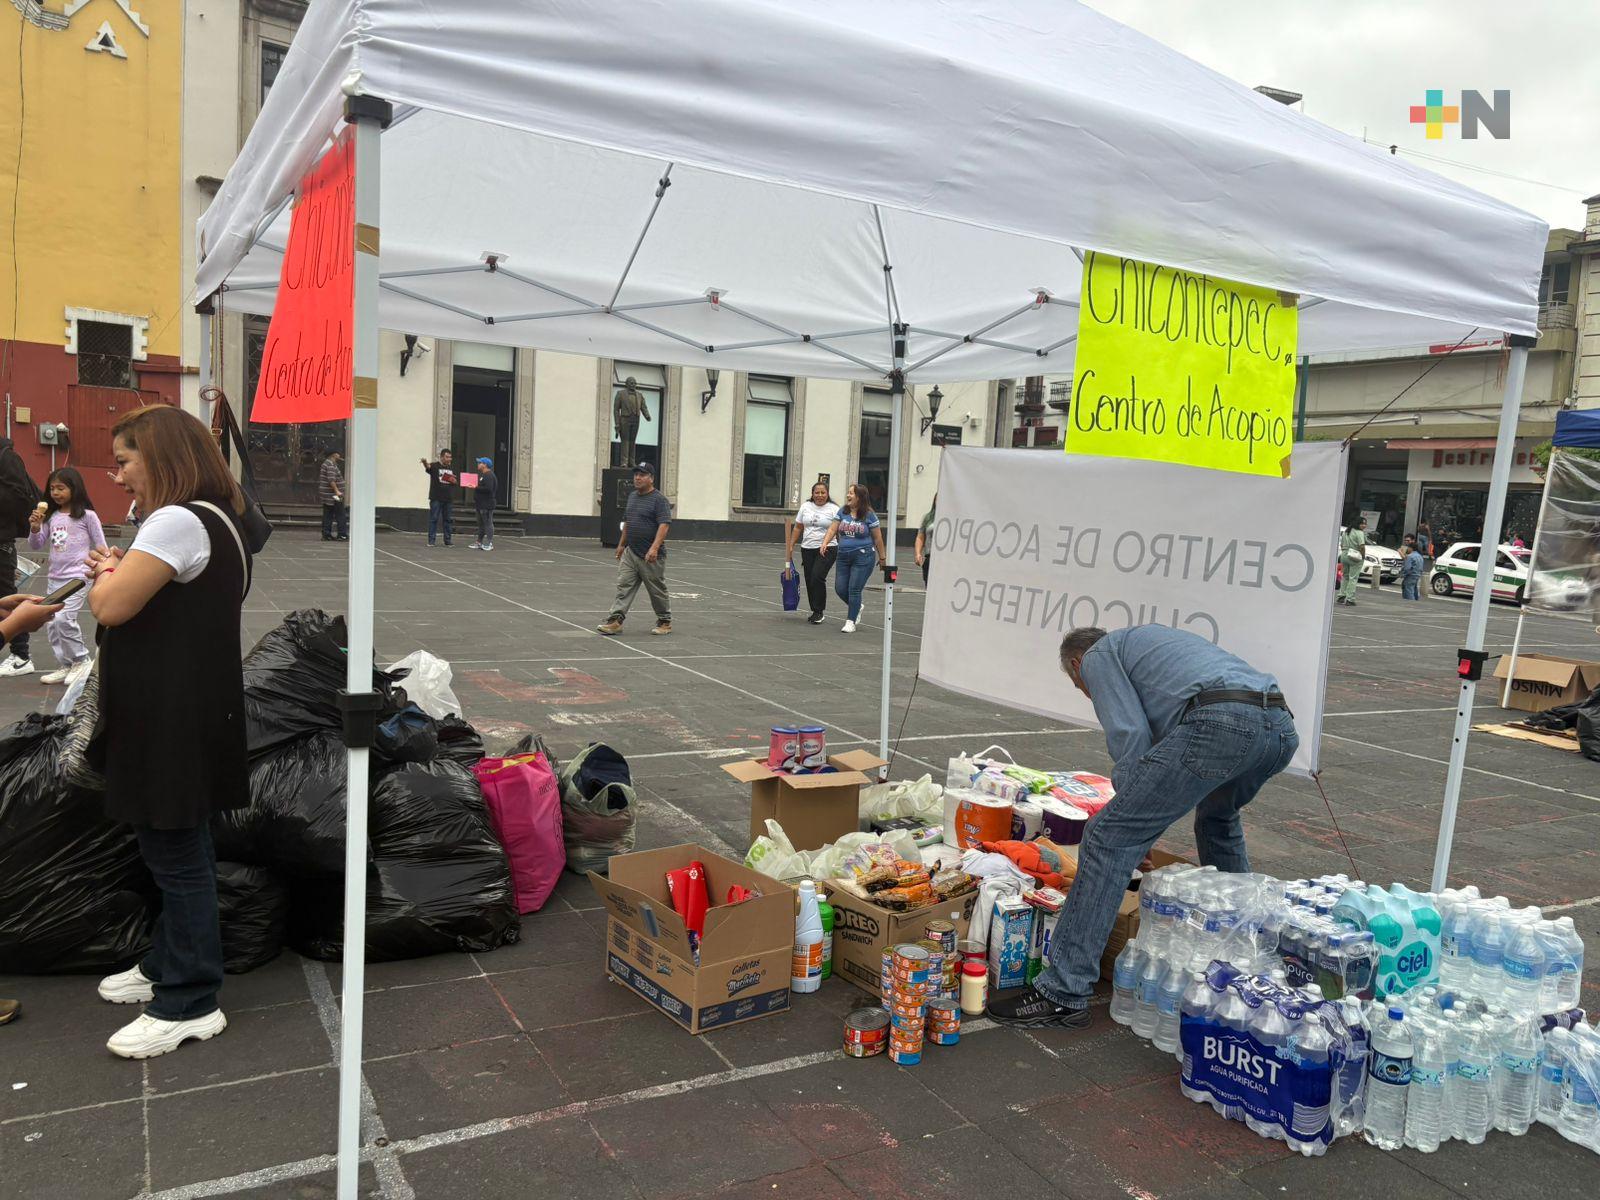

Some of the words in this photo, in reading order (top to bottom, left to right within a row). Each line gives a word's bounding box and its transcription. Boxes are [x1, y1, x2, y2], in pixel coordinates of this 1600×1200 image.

[264, 331, 314, 399] Centro
[316, 320, 332, 397] de
[332, 320, 353, 396] Aco
[1075, 370, 1166, 435] Centro
[1176, 375, 1203, 438] de
[1207, 384, 1287, 464] Acopio
[1511, 680, 1563, 698] MINISO
[832, 904, 880, 937] OREO
[841, 931, 874, 947] SANDWICH
[732, 958, 761, 976] Galletas
[1284, 964, 1314, 982] pura
[1397, 947, 1428, 973] ciel
[1203, 1036, 1283, 1085] BURST
[1210, 1064, 1228, 1078] AGUA
[1228, 1070, 1269, 1096] PURIFICADA
